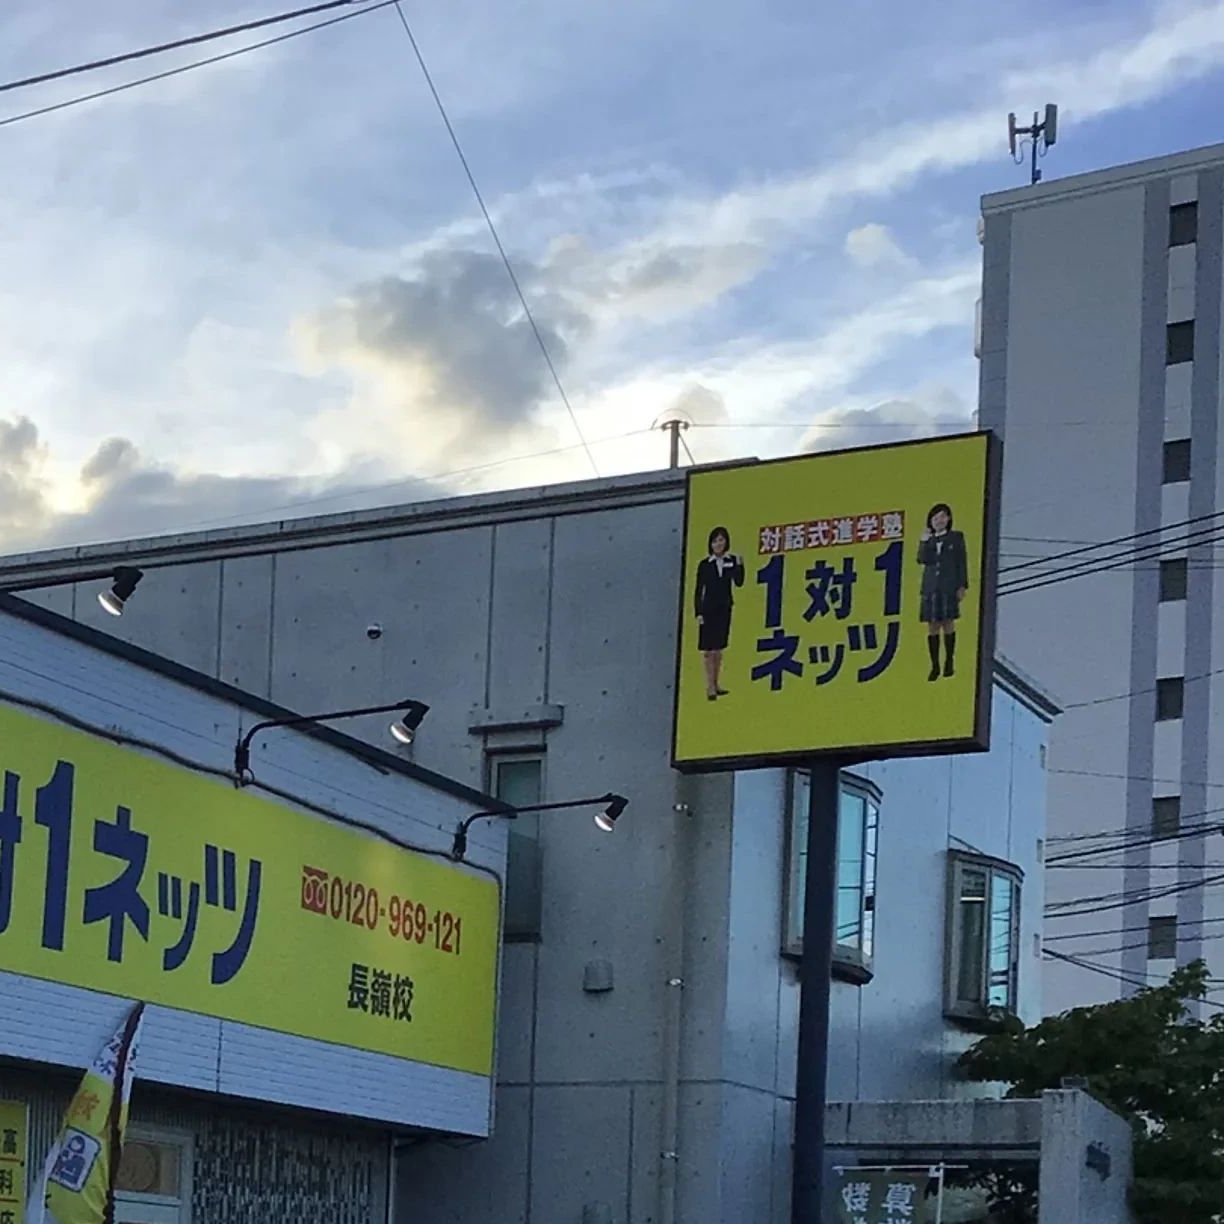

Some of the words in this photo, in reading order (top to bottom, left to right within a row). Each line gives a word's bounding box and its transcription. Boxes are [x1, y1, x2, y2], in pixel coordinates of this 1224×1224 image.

[759, 512, 903, 553] 対話式進学塾
[751, 622, 900, 691] ネッツ
[330, 876, 462, 955] 0120-969-121
[347, 963, 413, 1022] 長嶺校
